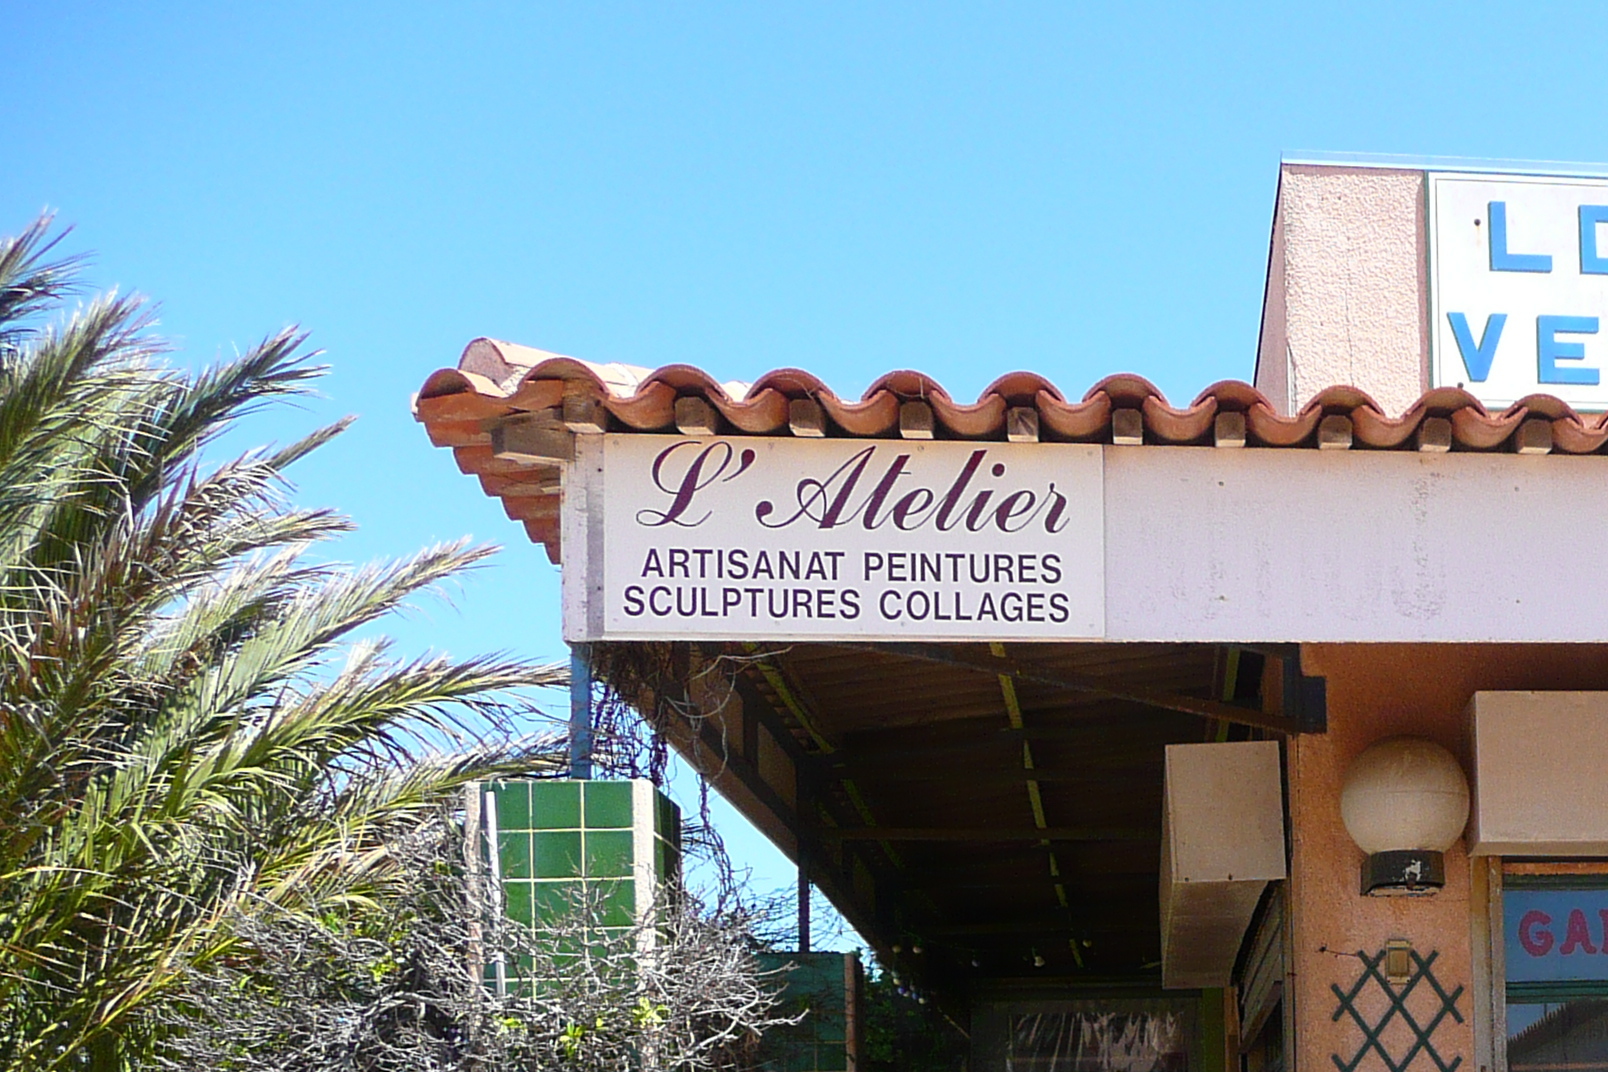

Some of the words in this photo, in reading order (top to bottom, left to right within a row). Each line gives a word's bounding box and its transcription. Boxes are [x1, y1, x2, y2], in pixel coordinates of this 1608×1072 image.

[641, 548, 846, 581] ARTISANAT
[863, 552, 1062, 584] PEINTURES
[623, 586, 861, 619] SCULPTURES
[879, 590, 1071, 624] COLLAGES
